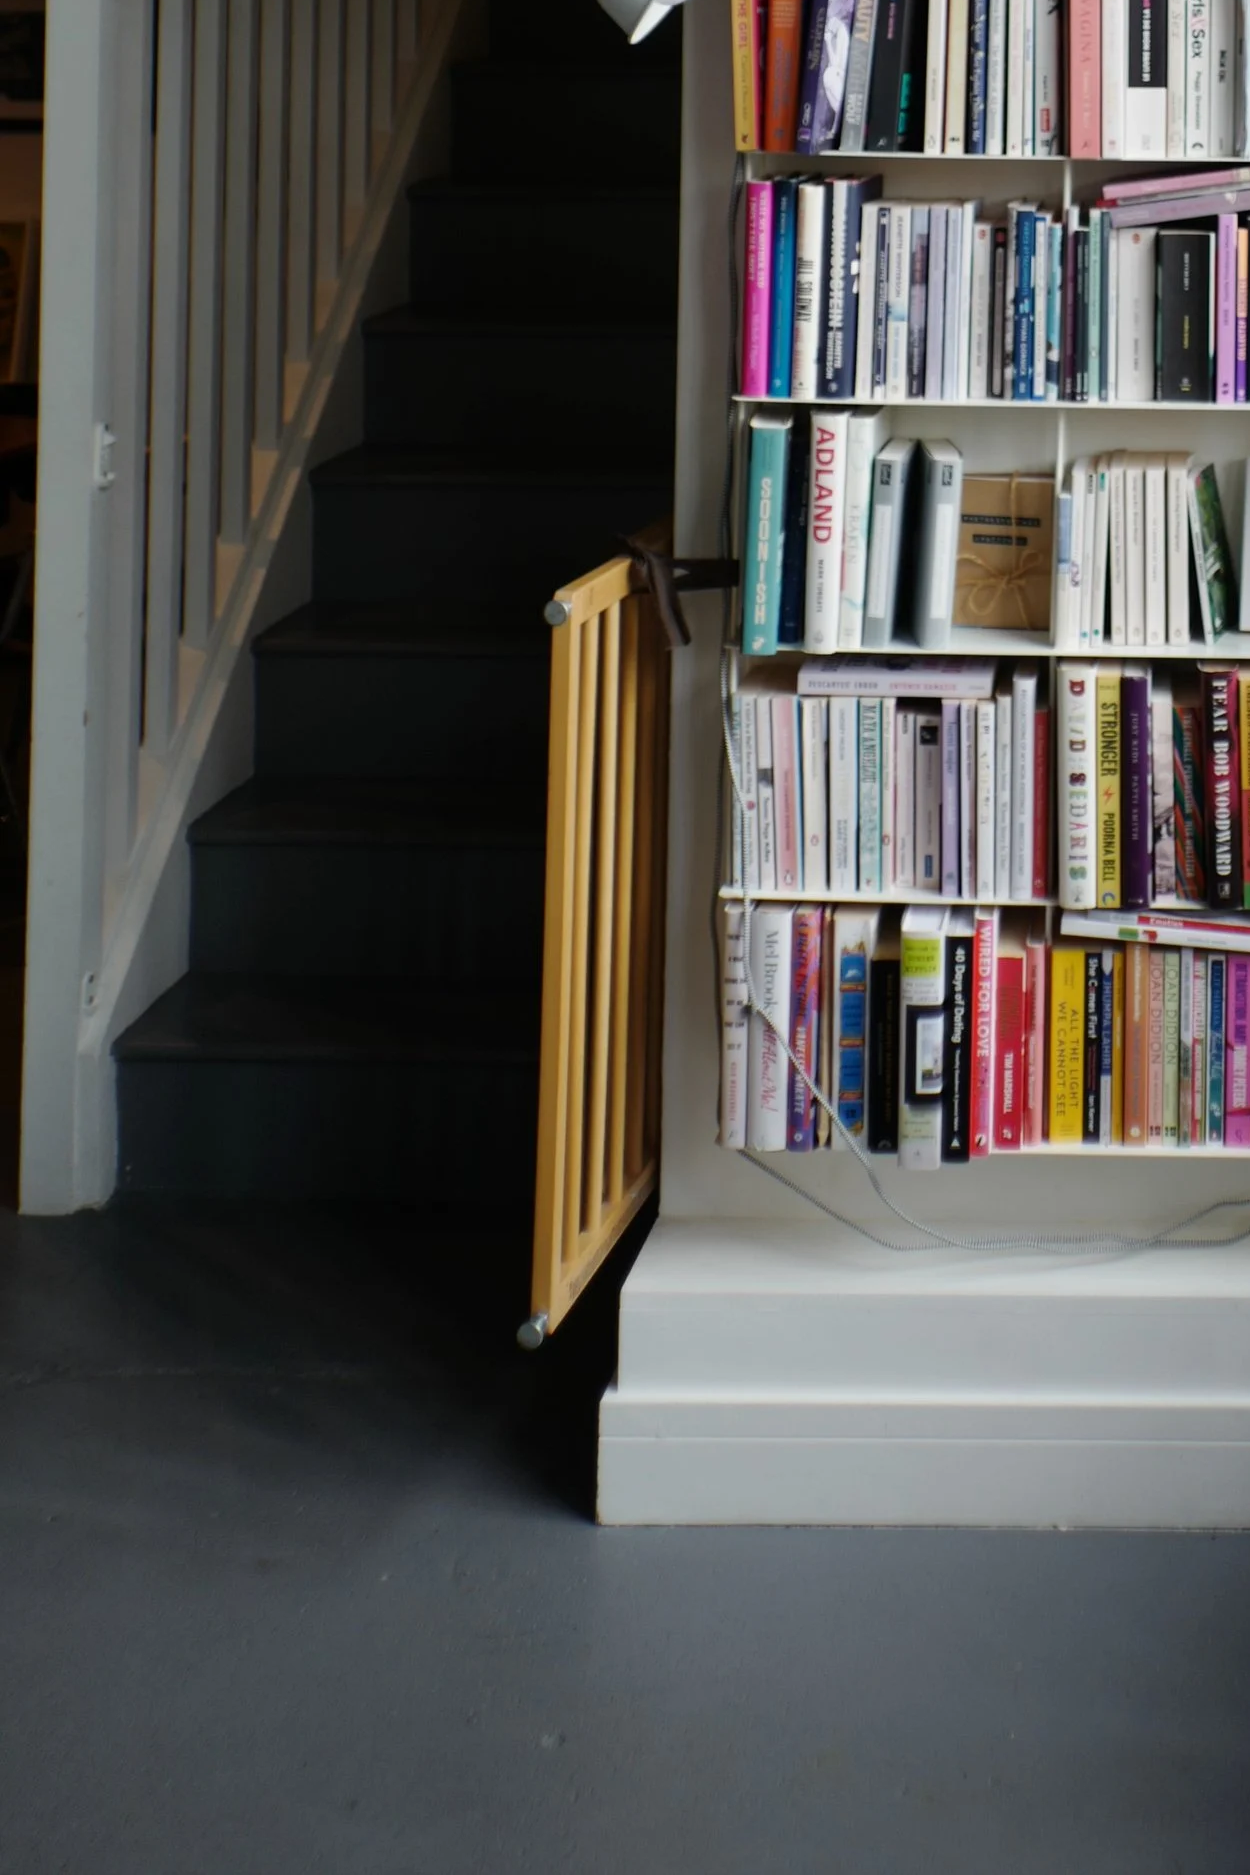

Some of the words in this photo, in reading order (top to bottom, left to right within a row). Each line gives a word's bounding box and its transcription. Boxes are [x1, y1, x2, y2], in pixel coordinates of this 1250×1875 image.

[1190, 29, 1205, 59] Sex
[812, 427, 836, 543] ADLAND
[1209, 679, 1229, 732] FEAR
[1099, 701, 1119, 778] STRONGER
[1211, 740, 1231, 776] BOB
[1101, 812, 1114, 855] POORNA
[1213, 780, 1233, 876] WOODWARD
[1101, 858, 1115, 883] BELL
[976, 926, 991, 977] WIRED
[976, 981, 991, 1010] FOR
[1055, 1001, 1066, 1019] WE
[975, 1014, 991, 1057] LOVE
[1068, 1008, 1079, 1032] ALL
[1055, 1024, 1066, 1085] CANNOT
[1068, 1038, 1079, 1065] THE
[1055, 1089, 1066, 1117] SEE
[1068, 1071, 1079, 1110] LIGHT
